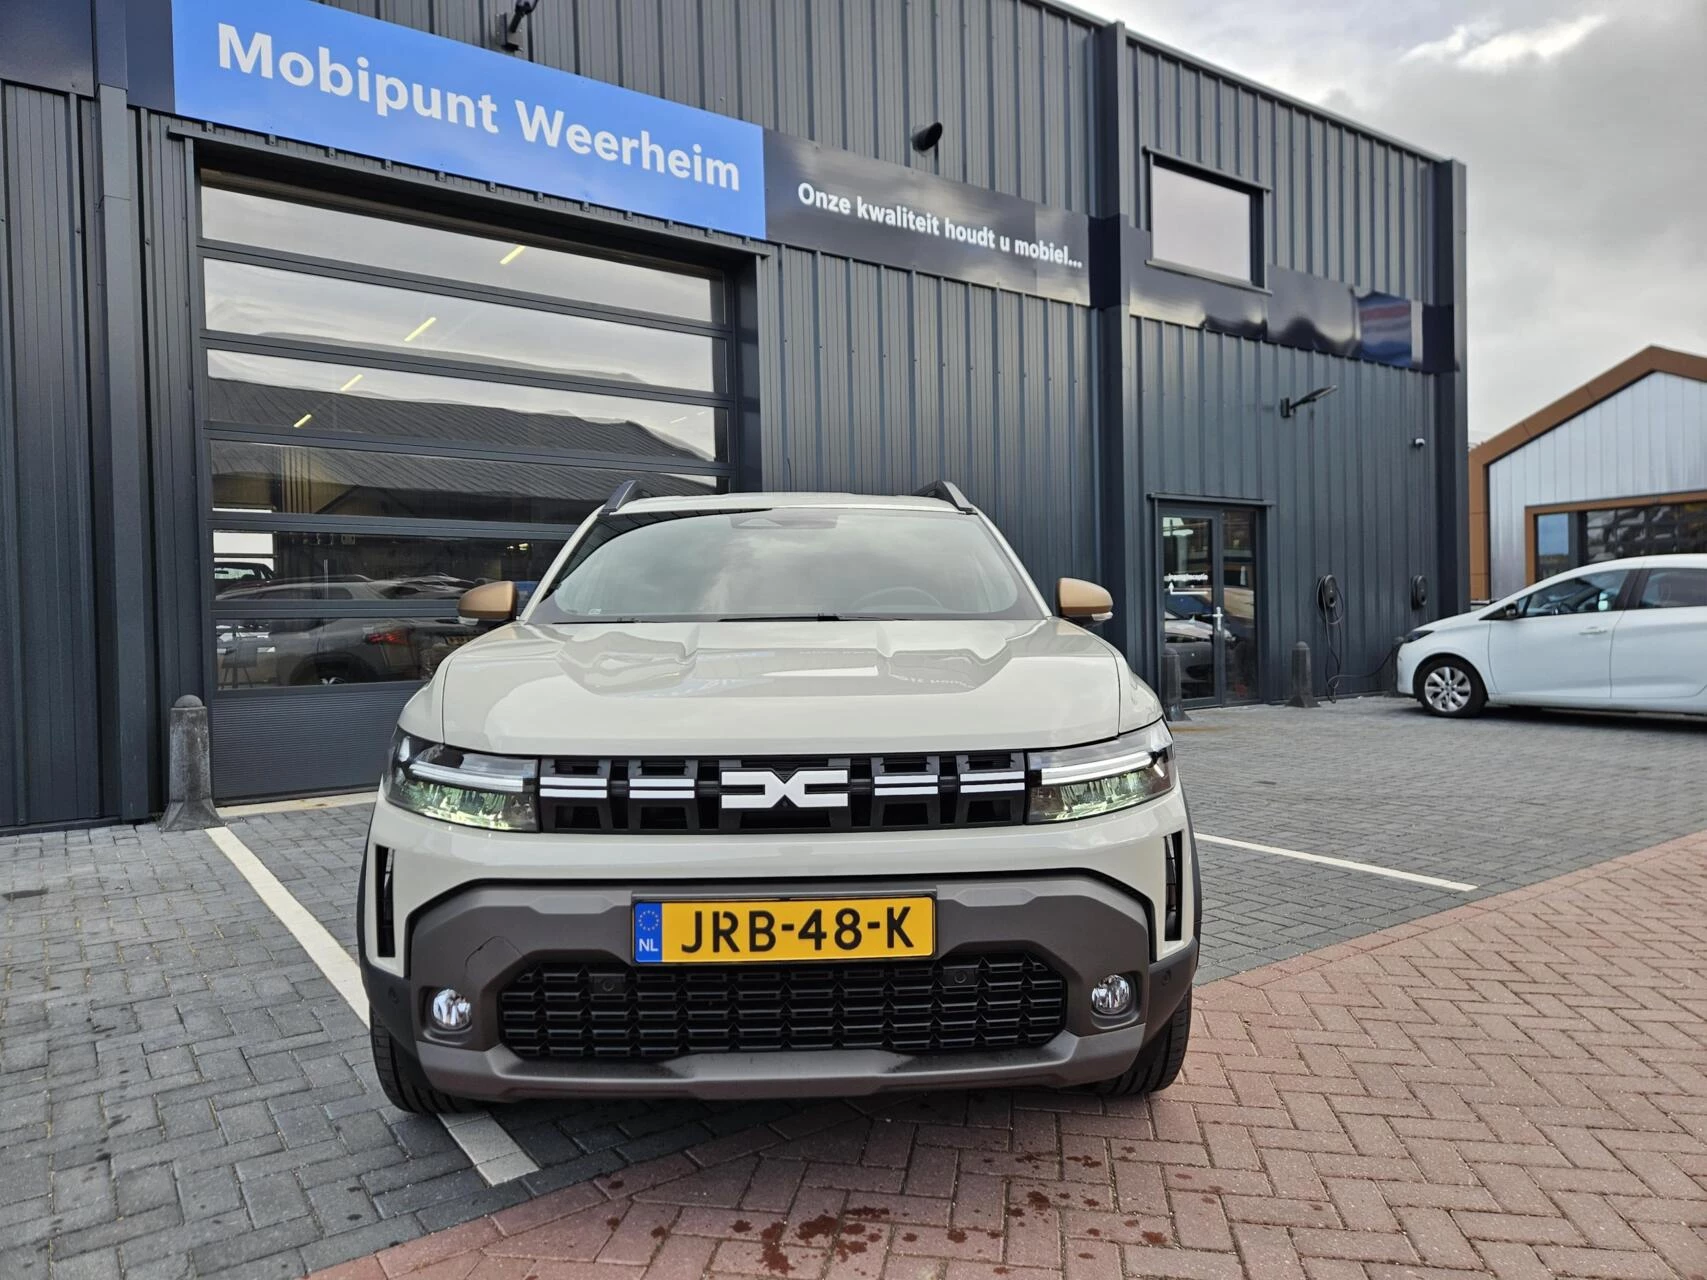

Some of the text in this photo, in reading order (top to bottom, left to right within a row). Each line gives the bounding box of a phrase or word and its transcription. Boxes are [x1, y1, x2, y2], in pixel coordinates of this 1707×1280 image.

[217, 22, 740, 192] Mobipunt Weerheim
[798, 183, 1083, 268] Onze kwaliteit houdt u mobiel...
[638, 938, 659, 953] NL
[681, 906, 914, 953] JRB-48-K
